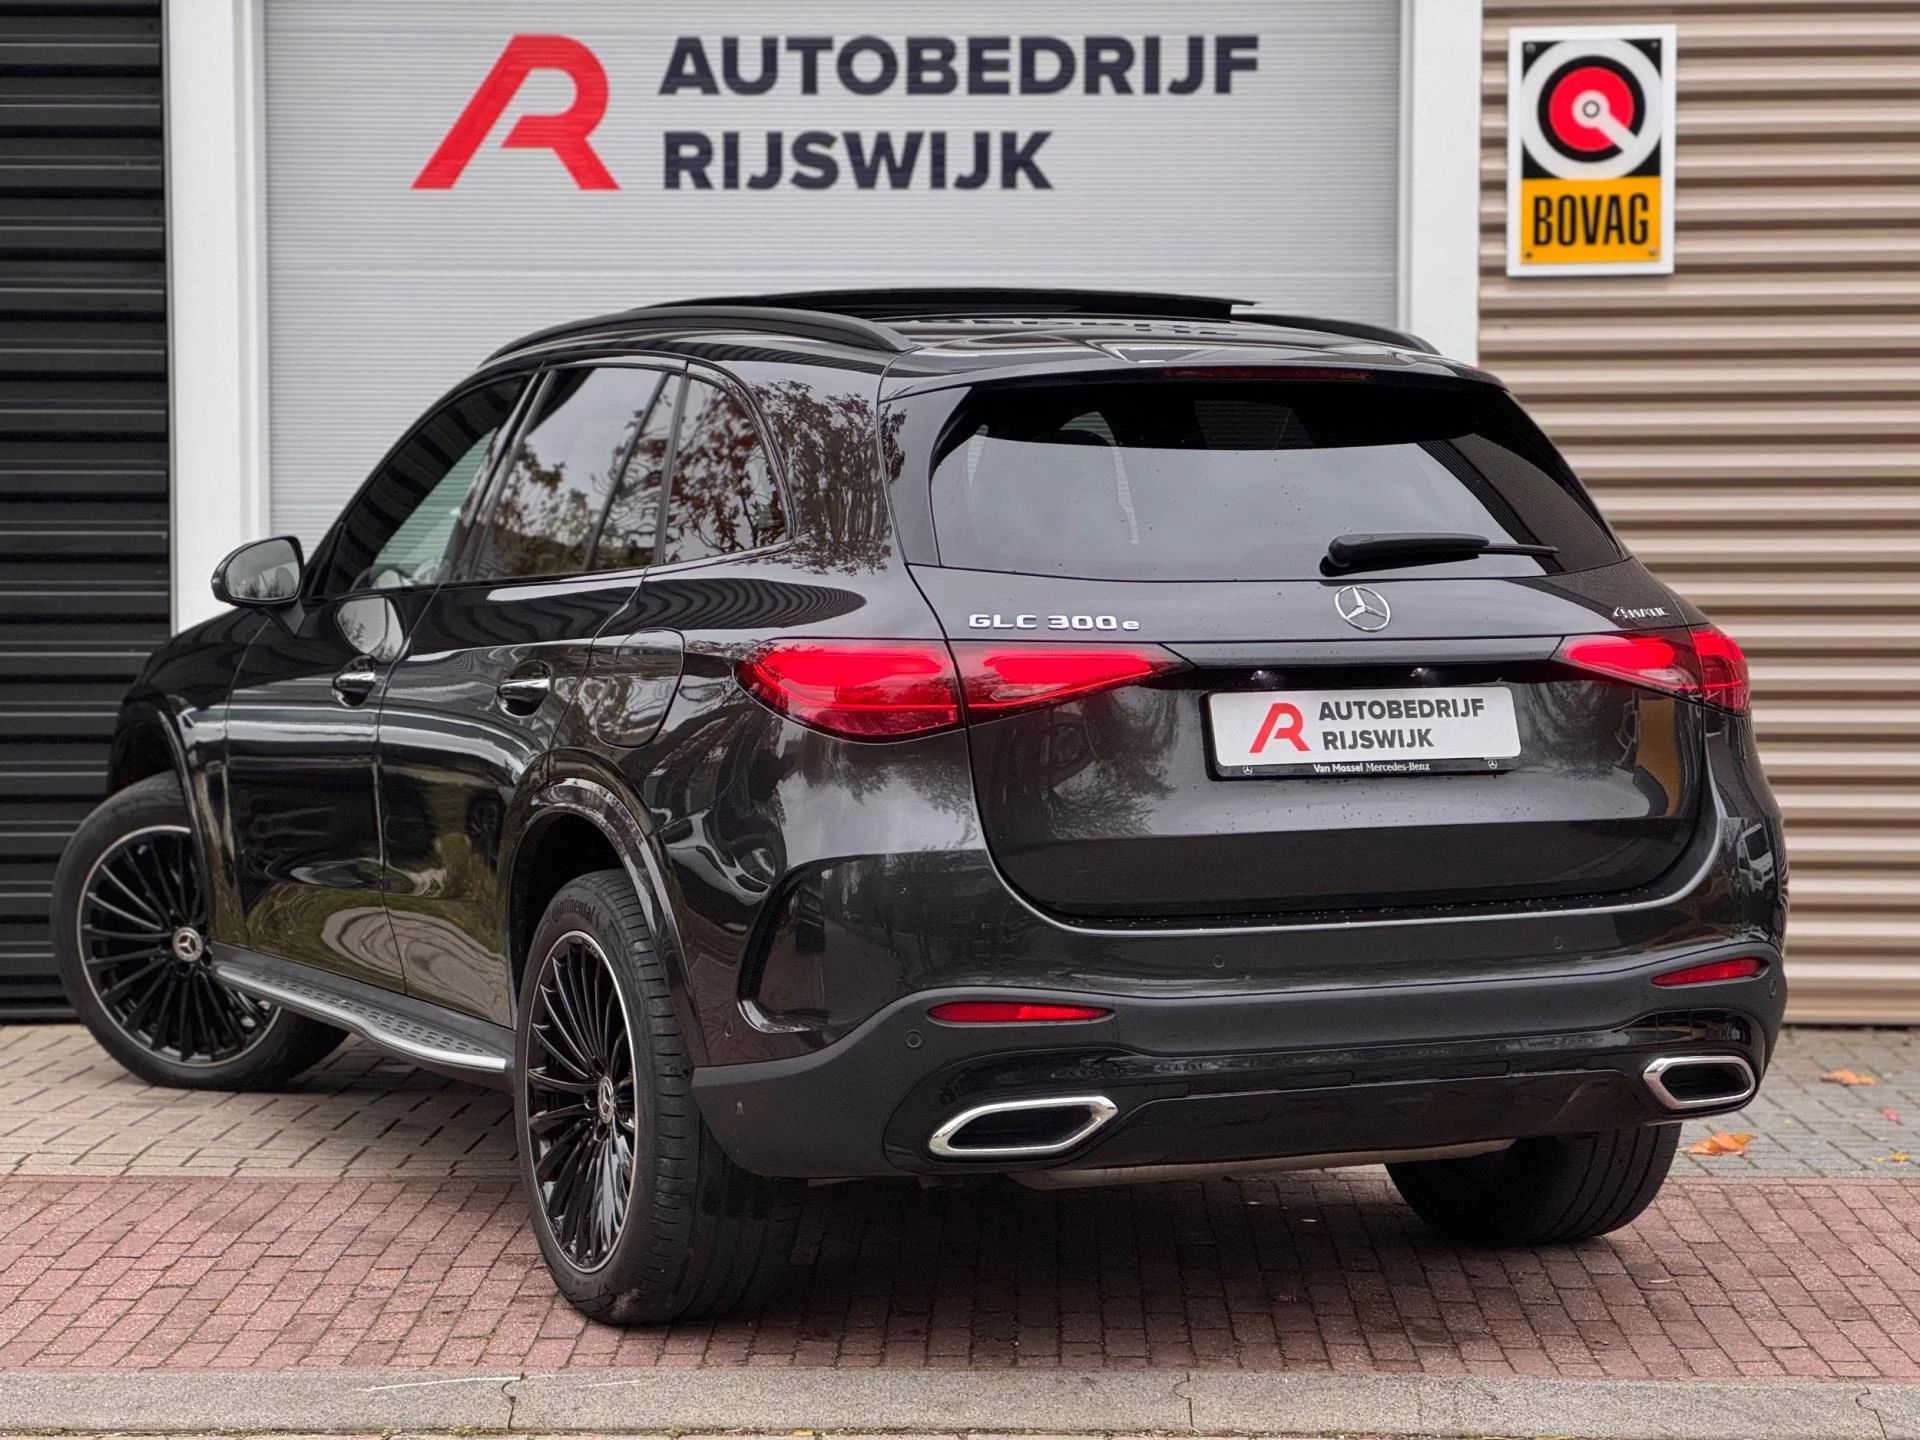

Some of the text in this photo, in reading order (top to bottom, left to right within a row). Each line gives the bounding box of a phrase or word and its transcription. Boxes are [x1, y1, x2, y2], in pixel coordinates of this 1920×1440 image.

[658, 34, 1260, 97] AUTOBEDRIJF
[662, 130, 1054, 191] RIJSWIJK
[1533, 192, 1649, 247] BOVAG
[968, 613, 1141, 632] GLC 300e
[1318, 698, 1486, 722] AUTOBEDRIJF
[1321, 728, 1435, 751] RIJSWIJK
[1313, 762, 1430, 774] Van Mossel Mercedes-Benz
[552, 896, 595, 923] Continental
